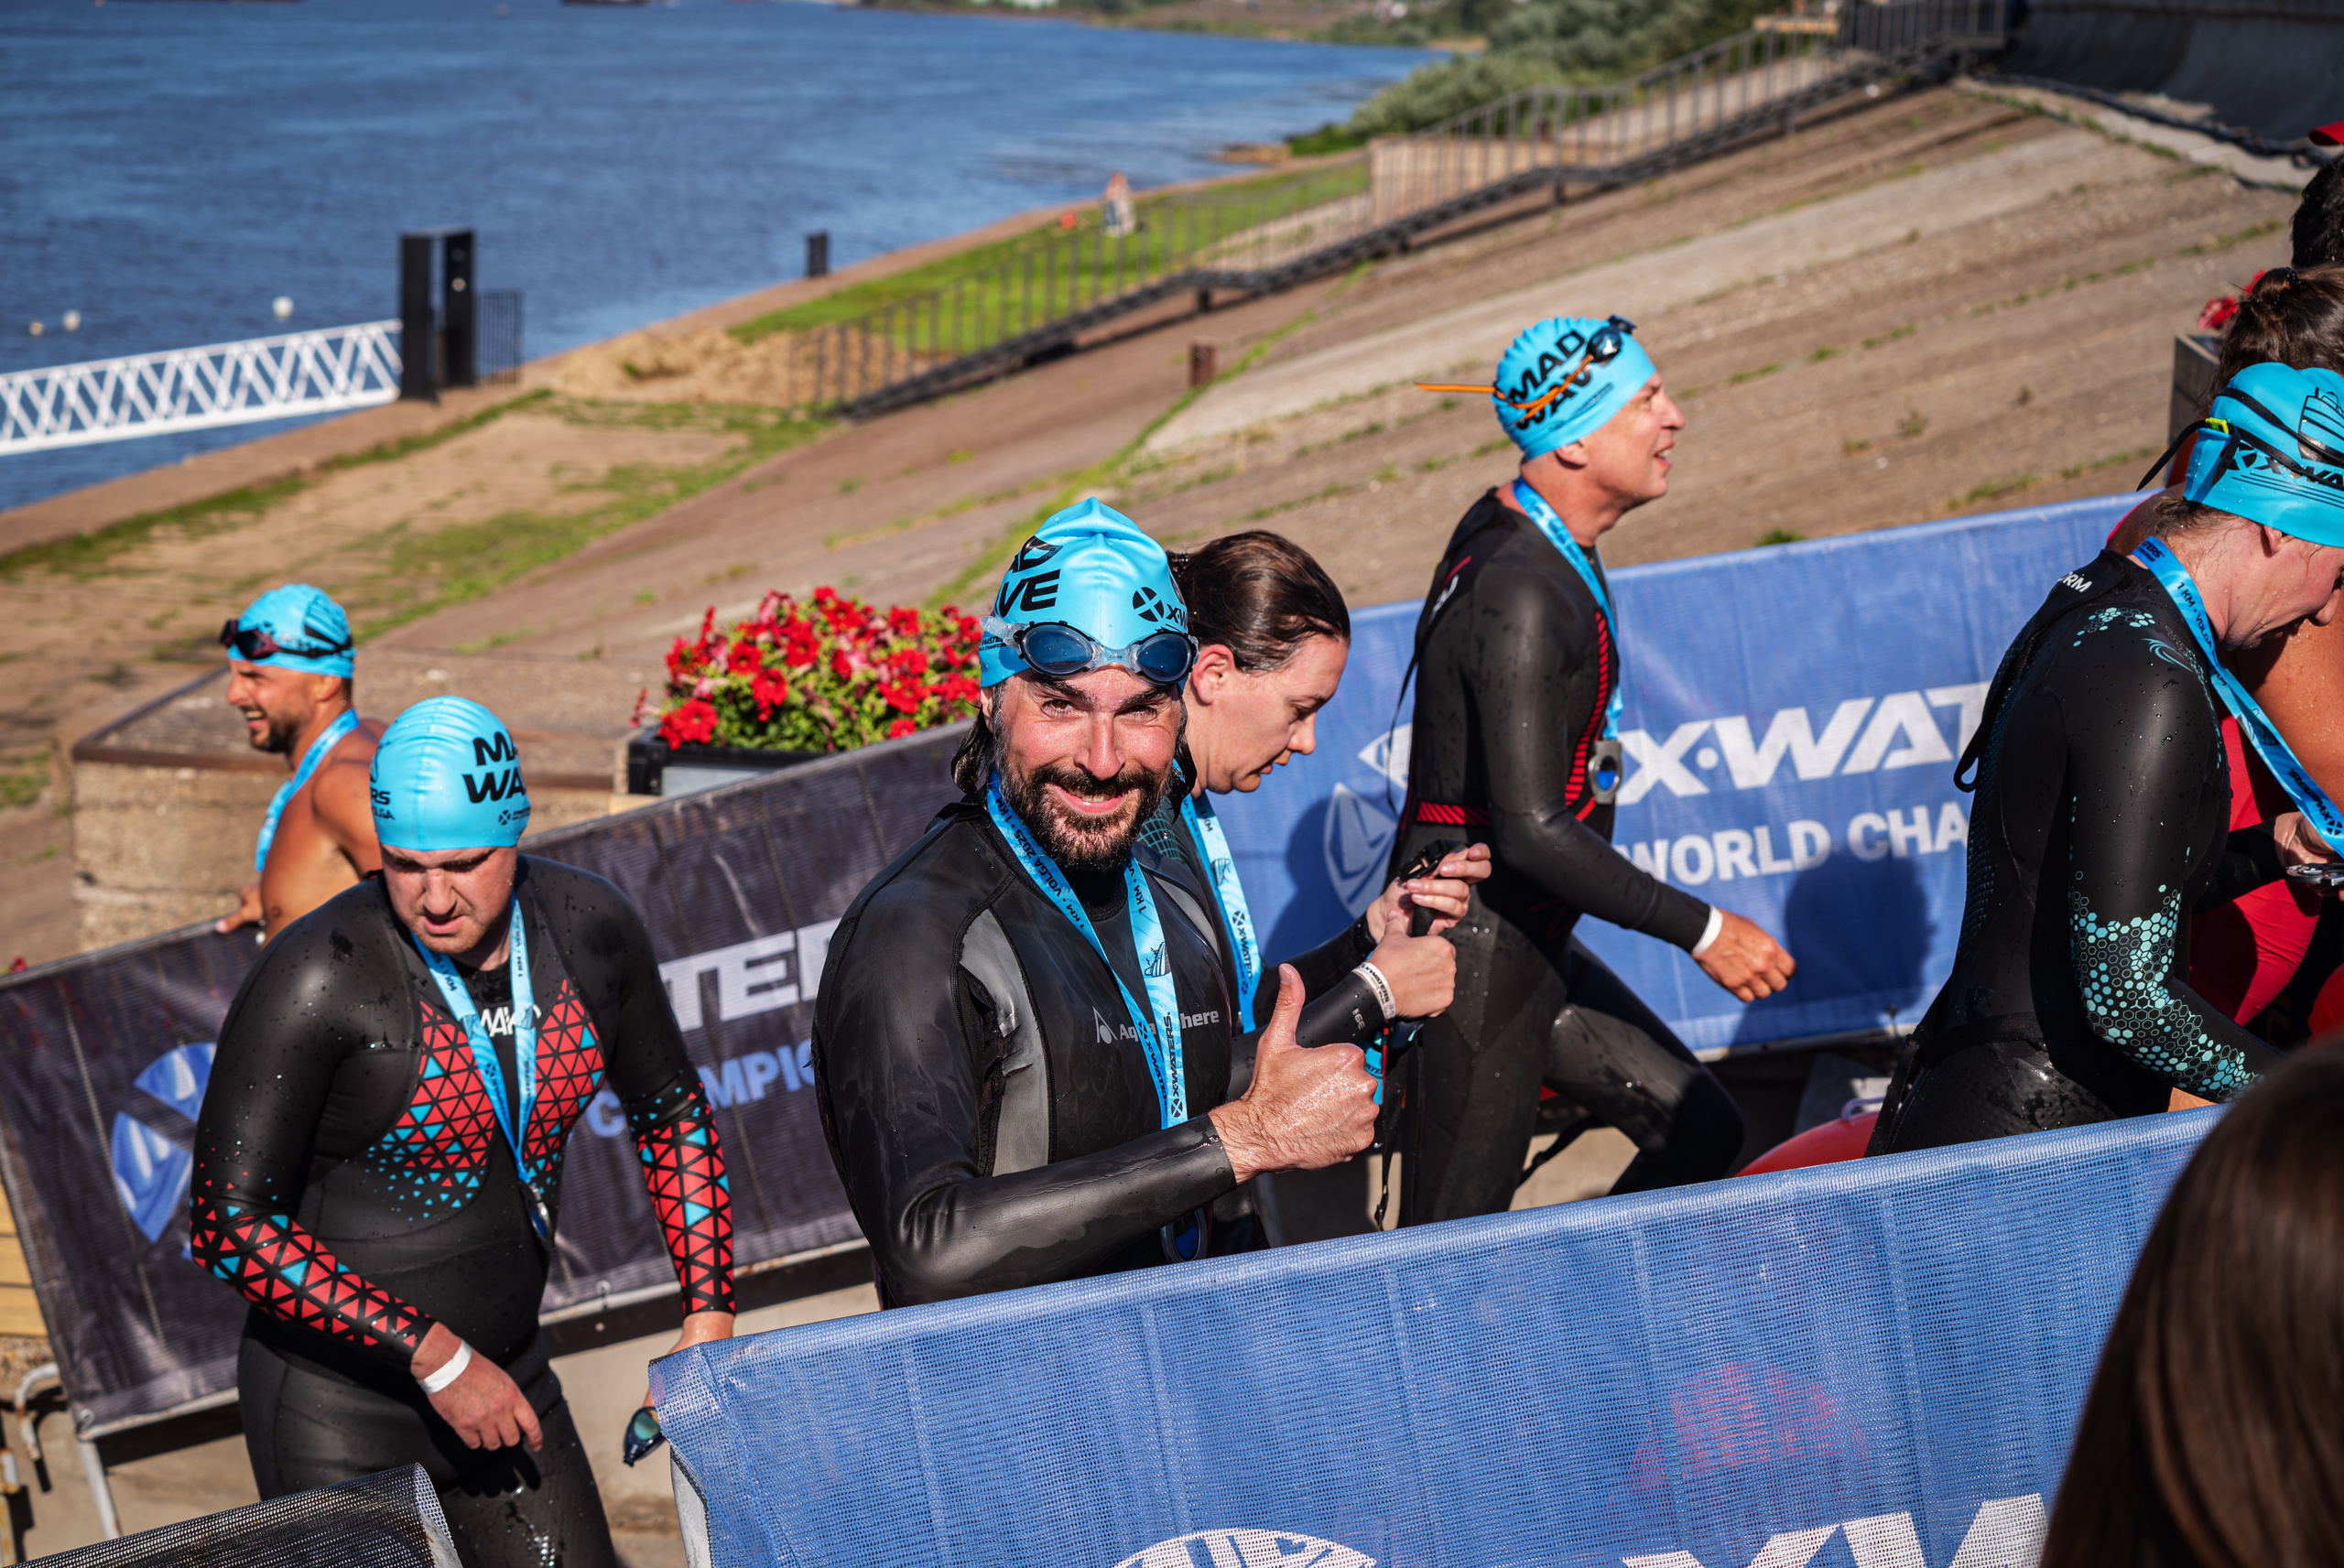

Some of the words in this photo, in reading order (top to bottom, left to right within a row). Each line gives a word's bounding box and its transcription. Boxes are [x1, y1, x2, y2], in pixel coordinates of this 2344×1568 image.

[1508, 330, 1585, 405] MAD
[996, 568, 1060, 618] VE
[2181, 589, 2196, 608] KM
[2196, 613, 2212, 648] VOLGA
[994, 797, 1007, 815] KM
[1013, 828, 1036, 859] 2025
[1616, 819, 1832, 885] WORLD
[1847, 802, 1968, 861] CHA
[1034, 860, 1062, 897] VOLGA
[1133, 884, 1145, 903] KM
[1066, 903, 1079, 922] KM
